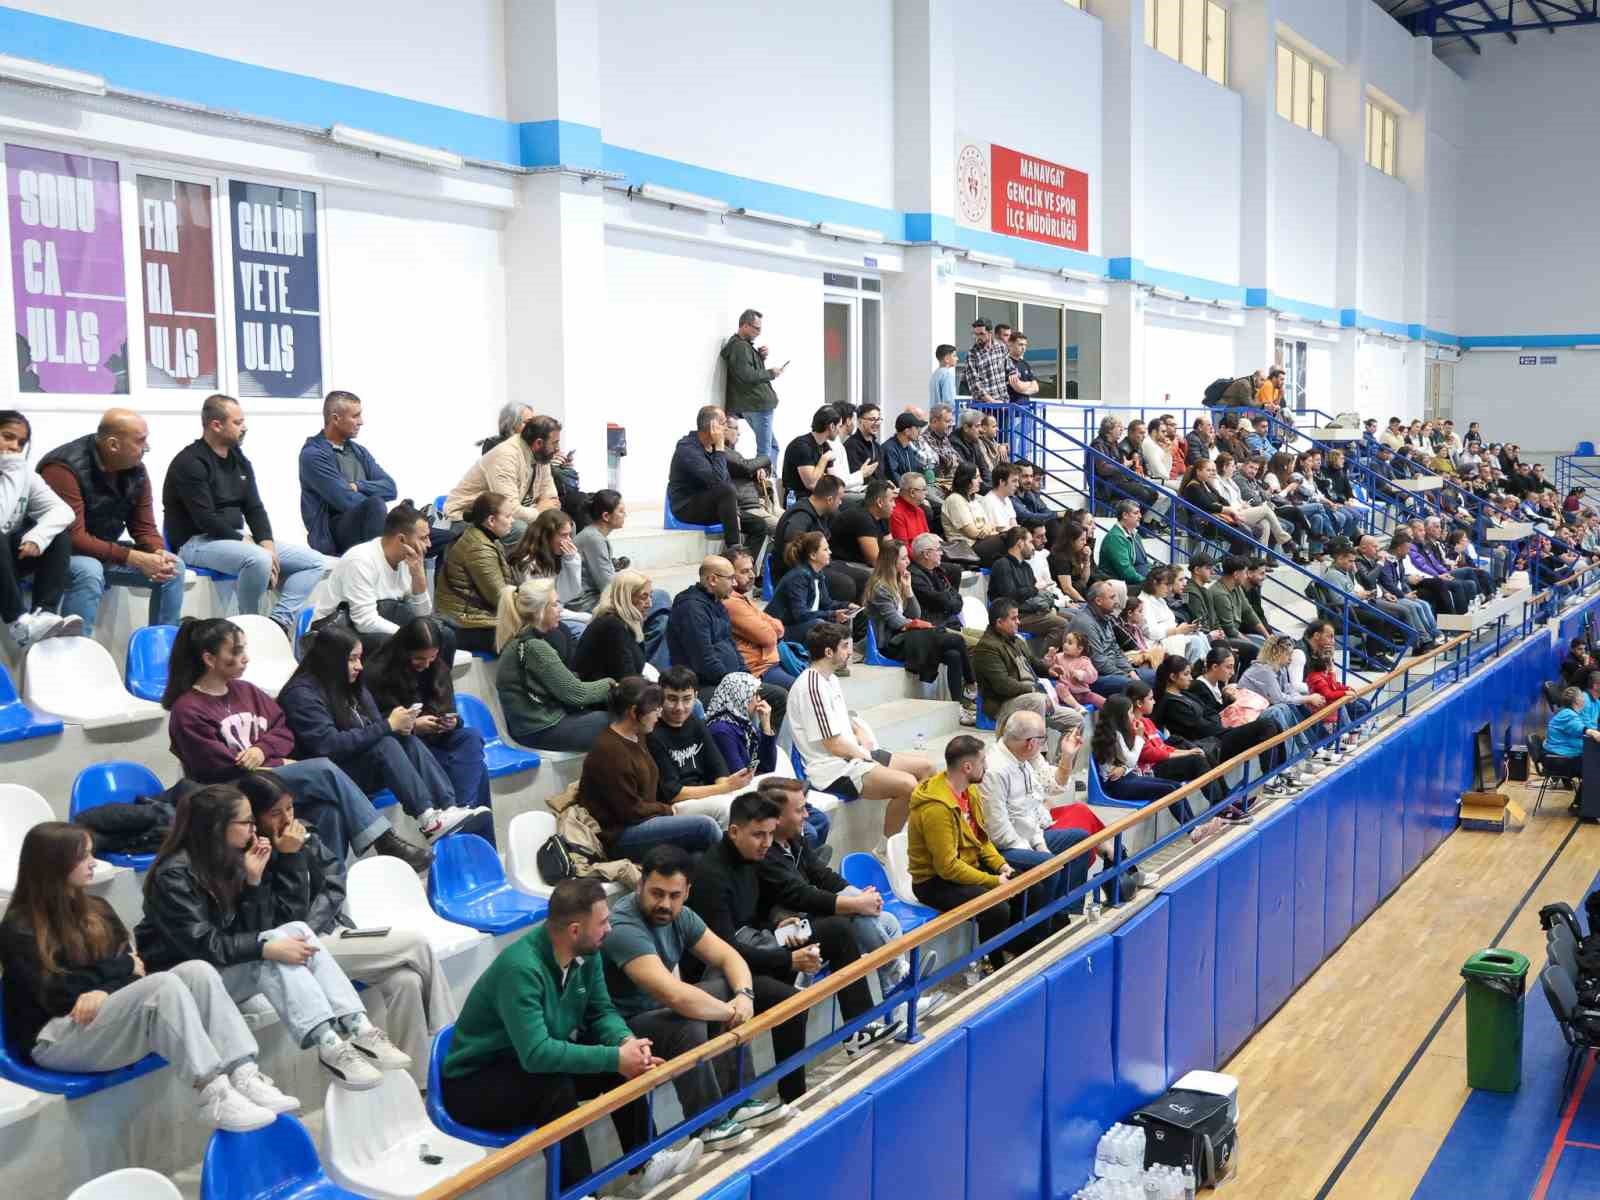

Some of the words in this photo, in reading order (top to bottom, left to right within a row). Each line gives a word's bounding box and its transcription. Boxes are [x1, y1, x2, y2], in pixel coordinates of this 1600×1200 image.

[19, 169, 96, 233] SONU
[1007, 181, 1043, 209] GENÇLİK
[1044, 191, 1055, 211] VE
[1056, 194, 1076, 217] SPOR
[1020, 158, 1065, 188] MANAVGAT
[238, 201, 304, 257] GALİBİ
[1006, 203, 1025, 234] İLÇE
[1027, 209, 1077, 241] MÜDÜRLÜĞÜ
[23, 239, 62, 296] CA
[240, 261, 292, 314] YETE
[26, 306, 100, 372] ULAŞ
[243, 321, 295, 378] ULAŞ
